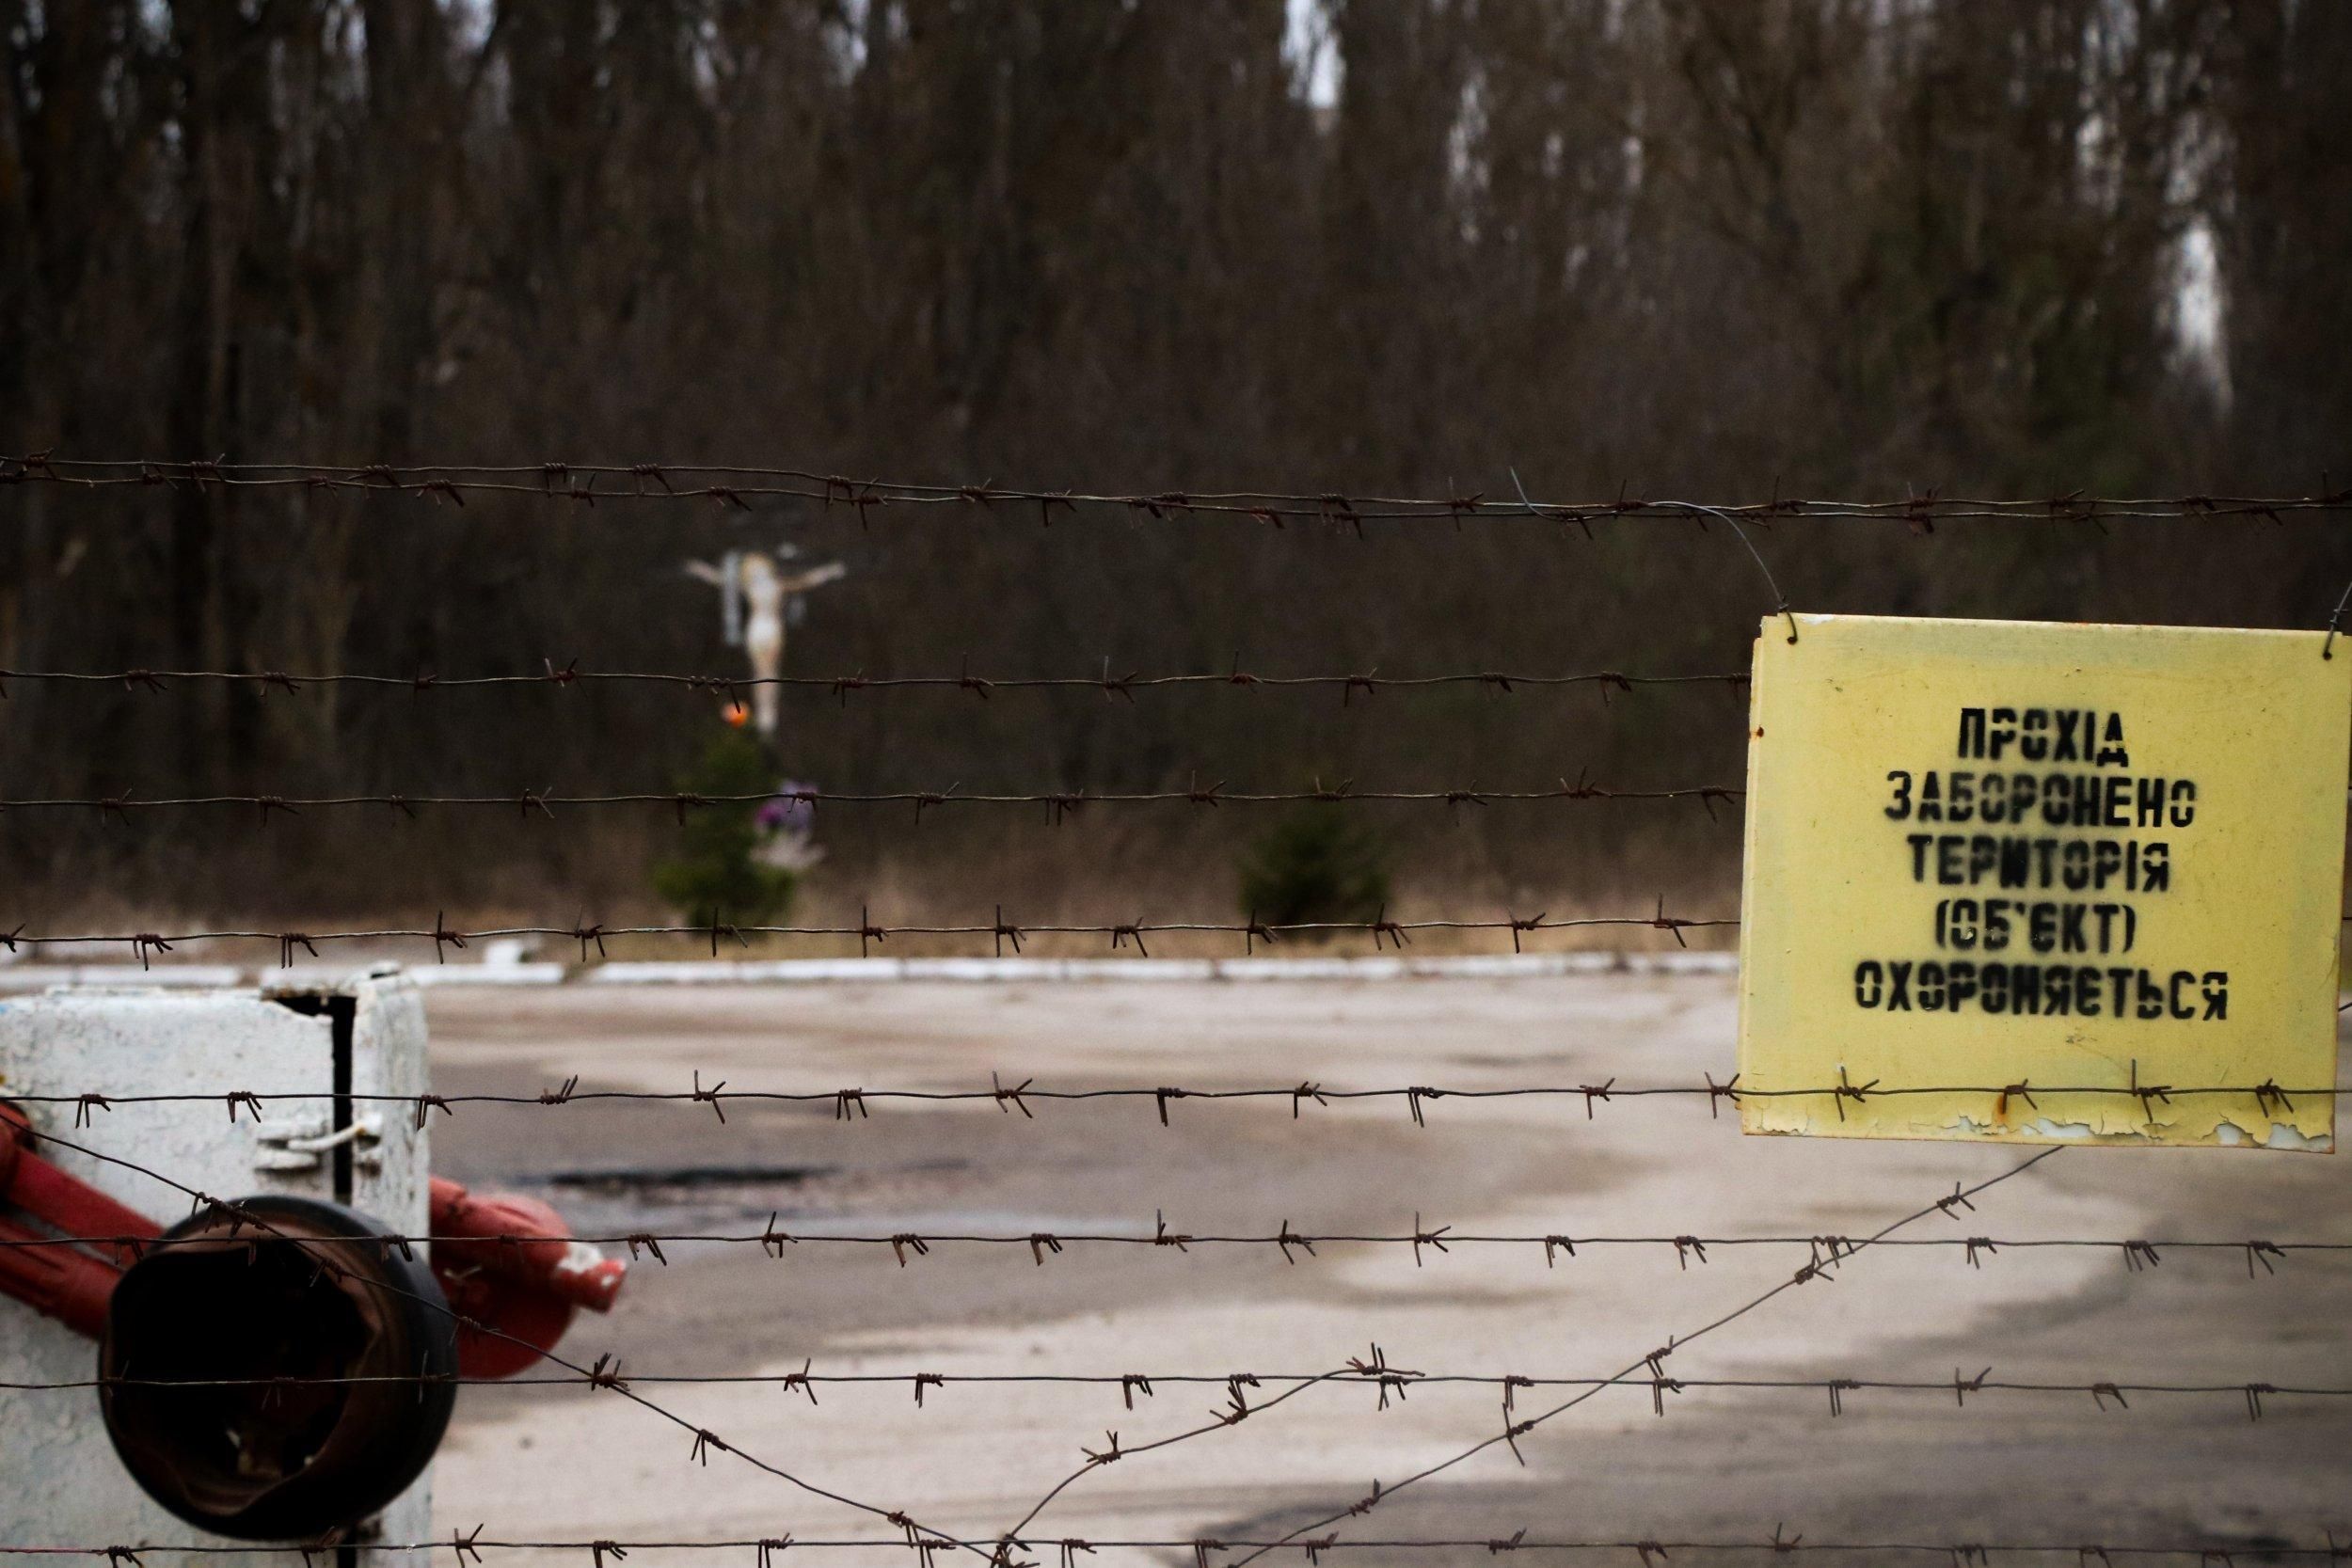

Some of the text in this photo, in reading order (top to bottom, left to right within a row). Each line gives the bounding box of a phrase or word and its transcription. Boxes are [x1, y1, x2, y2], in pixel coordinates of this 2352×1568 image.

[1957, 707, 2129, 768] ПРОХІД
[1883, 770, 2197, 829] ЗАБОРОНЕНО
[1907, 833, 2170, 893] ТЕРИТОРІЯ
[1854, 959, 2230, 1022] ОХОРОНЯЄТЬСЯ
